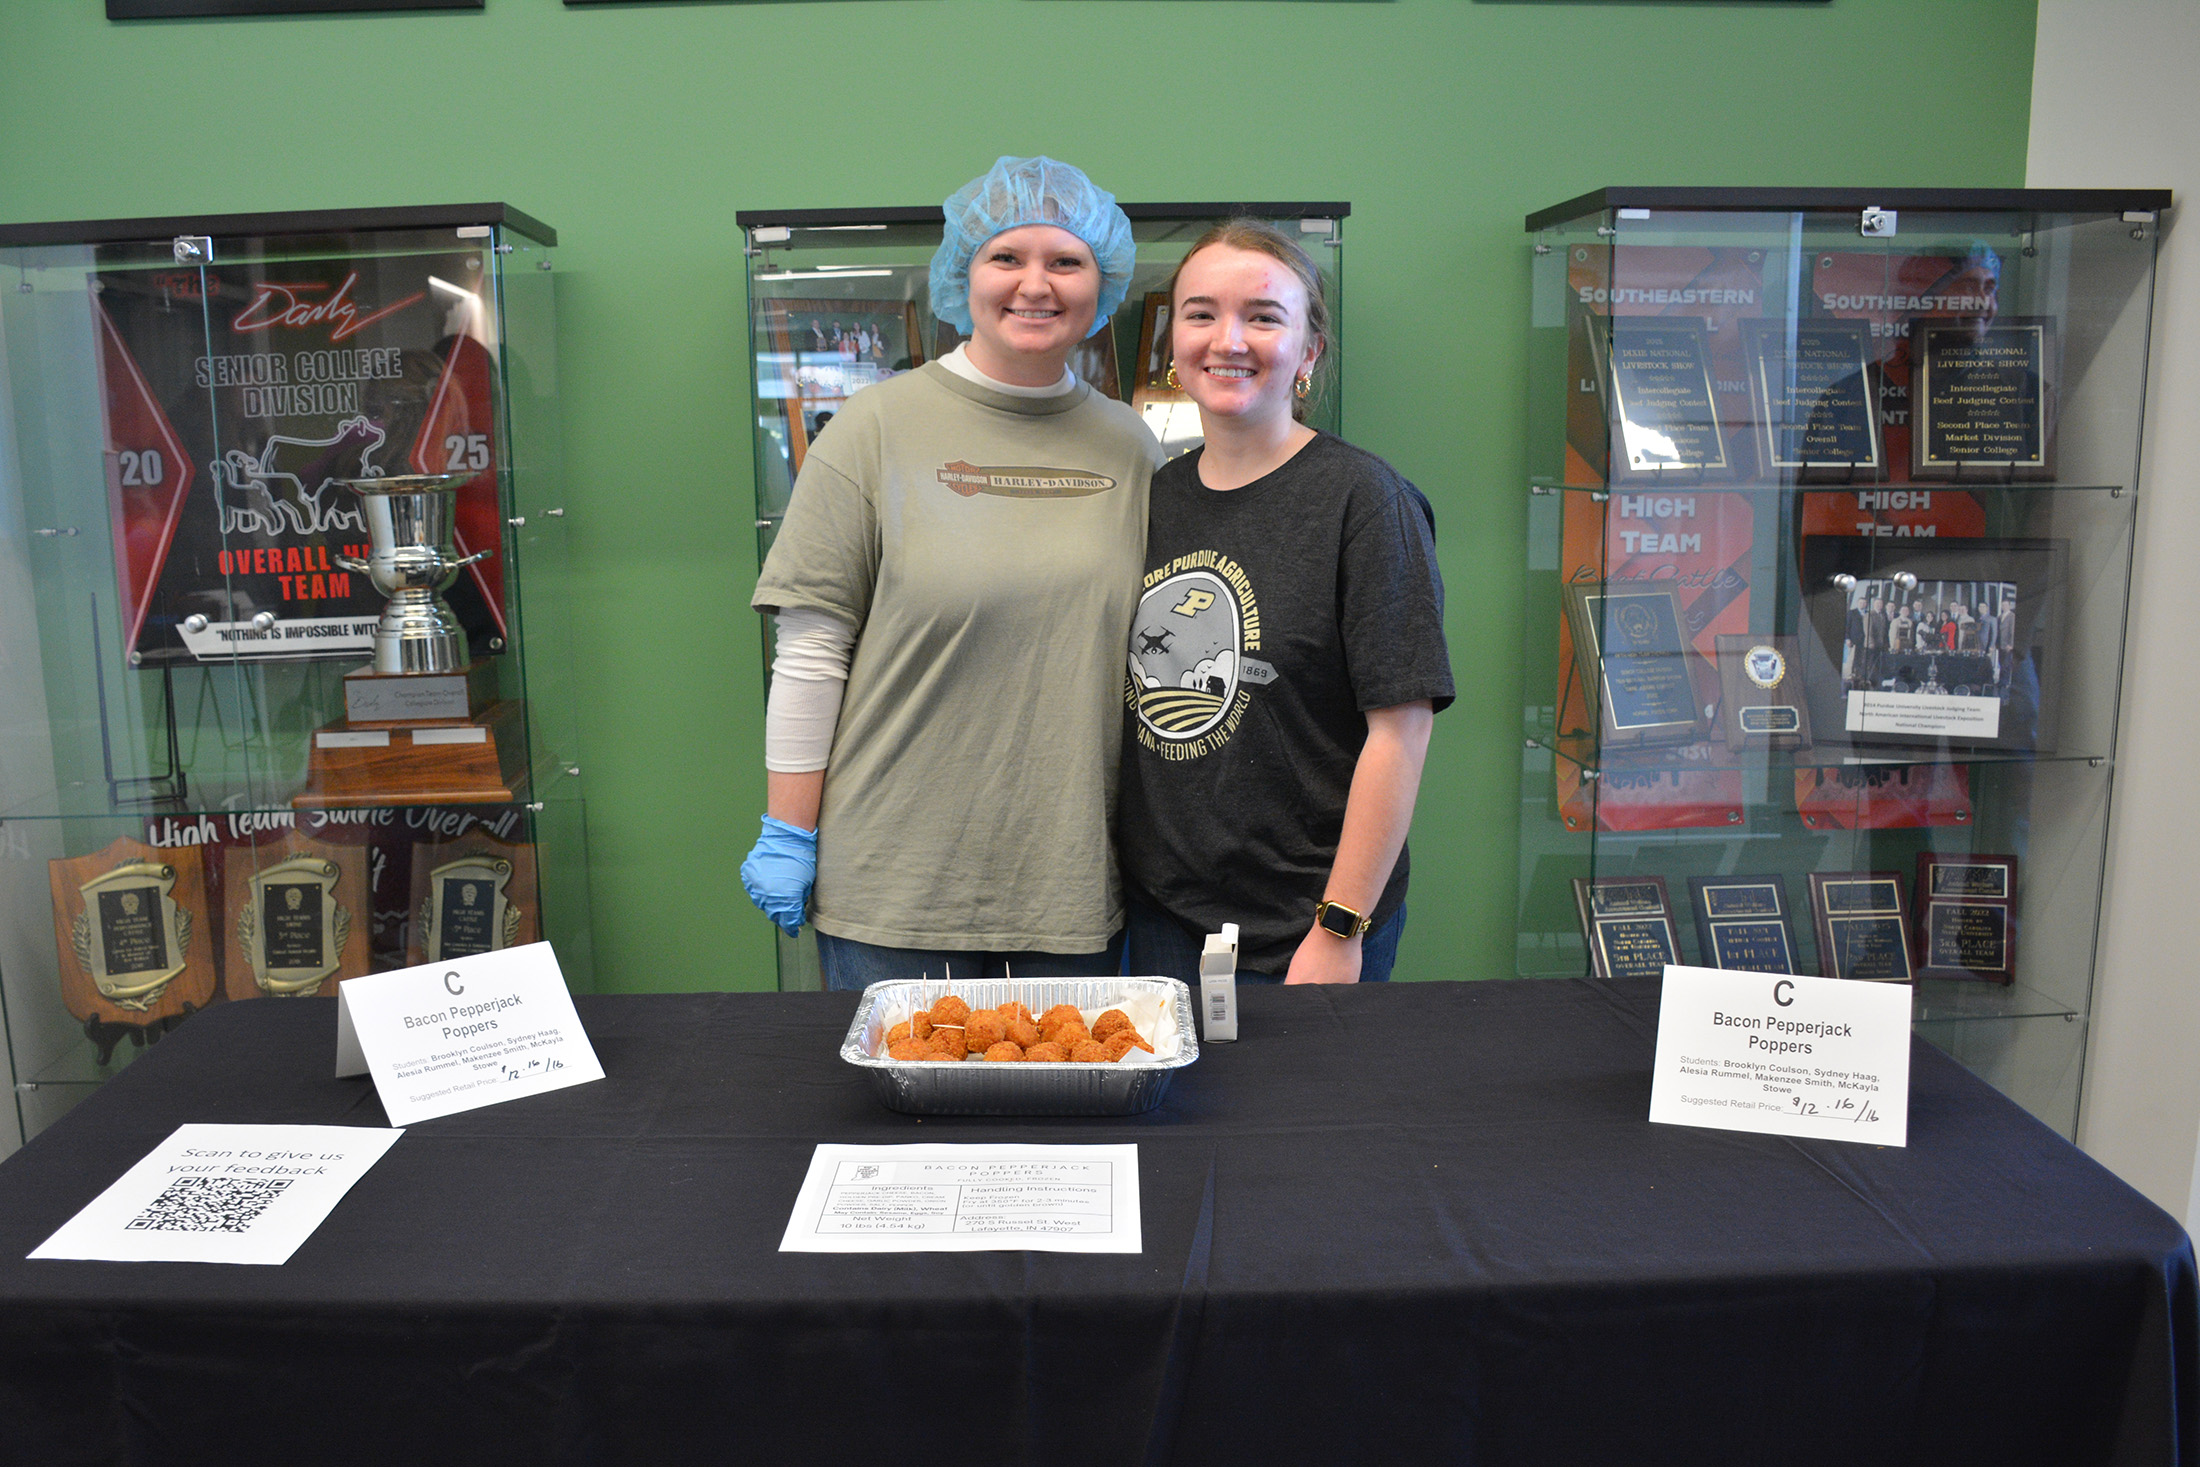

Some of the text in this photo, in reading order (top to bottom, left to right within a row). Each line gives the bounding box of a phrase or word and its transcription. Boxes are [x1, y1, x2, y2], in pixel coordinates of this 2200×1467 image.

[1579, 286, 1754, 304] SOUTHEASTERN
[1823, 293, 1990, 310] SOUTHEASTERN
[1941, 347, 2027, 356] DIXIE NATIONAL
[195, 348, 402, 387] SENIOR COLLEGE
[1937, 360, 1994, 368] LIVESTOCK
[1950, 385, 2017, 393] Intercollegiate
[243, 384, 358, 417] DIVISION
[1957, 397, 1996, 406] Judging
[1937, 421, 1970, 429] Second
[1806, 435, 1838, 443] Overall
[445, 434, 490, 470] 25
[1983, 446, 2018, 454] College
[119, 450, 163, 486] 20
[940, 472, 988, 484] HARLEY-DAVIDSON
[994, 477, 1106, 488] HARLEY-DAVIDSON
[1620, 495, 1695, 518] HIGH
[1857, 491, 1930, 510] HIGH
[1620, 531, 1701, 553] TEAM
[218, 546, 330, 575] OVERALL
[278, 573, 350, 600] TEAM
[1170, 587, 1216, 618] P
[1172, 549, 1261, 652] PURDUE AGRICULTURE
[271, 628, 282, 640] IS
[286, 625, 350, 639] IMPOSSIBLE
[1243, 665, 1268, 678] 1869
[1161, 690, 1251, 761] FEEDING THE WORLD
[444, 971, 464, 995] C
[1773, 980, 1795, 1007] C
[403, 994, 523, 1029] Bacon Pepperjack
[442, 1019, 498, 1039] Poppers
[1713, 1012, 1852, 1037] Bacon Pepperjack
[393, 1028, 561, 1070] Students: Brooklyn Coulson, Sydney Haag,
[1749, 1036, 1813, 1054] Poppers
[397, 1036, 563, 1079] Alesia Rummel, Makenzee Smith, McKayla
[473, 1060, 499, 1071] Stowe
[1680, 1056, 1881, 1083] Students: Brooklyn Coulson, Sydney Haag,
[1680, 1066, 1880, 1093] Alesia Rummel, Makenzee Smith, McKayla
[410, 1087, 452, 1103] Suggested
[453, 1081, 476, 1094] Retail
[1762, 1084, 1793, 1094] Stowe
[1680, 1095, 1728, 1108] Suggested
[1731, 1098, 1757, 1110] Retail
[1758, 1102, 1785, 1113] Price:
[181, 1149, 232, 1157] Scan
[240, 1150, 261, 1158] to
[265, 1150, 313, 1160] give
[166, 1164, 328, 1174] your feedback
